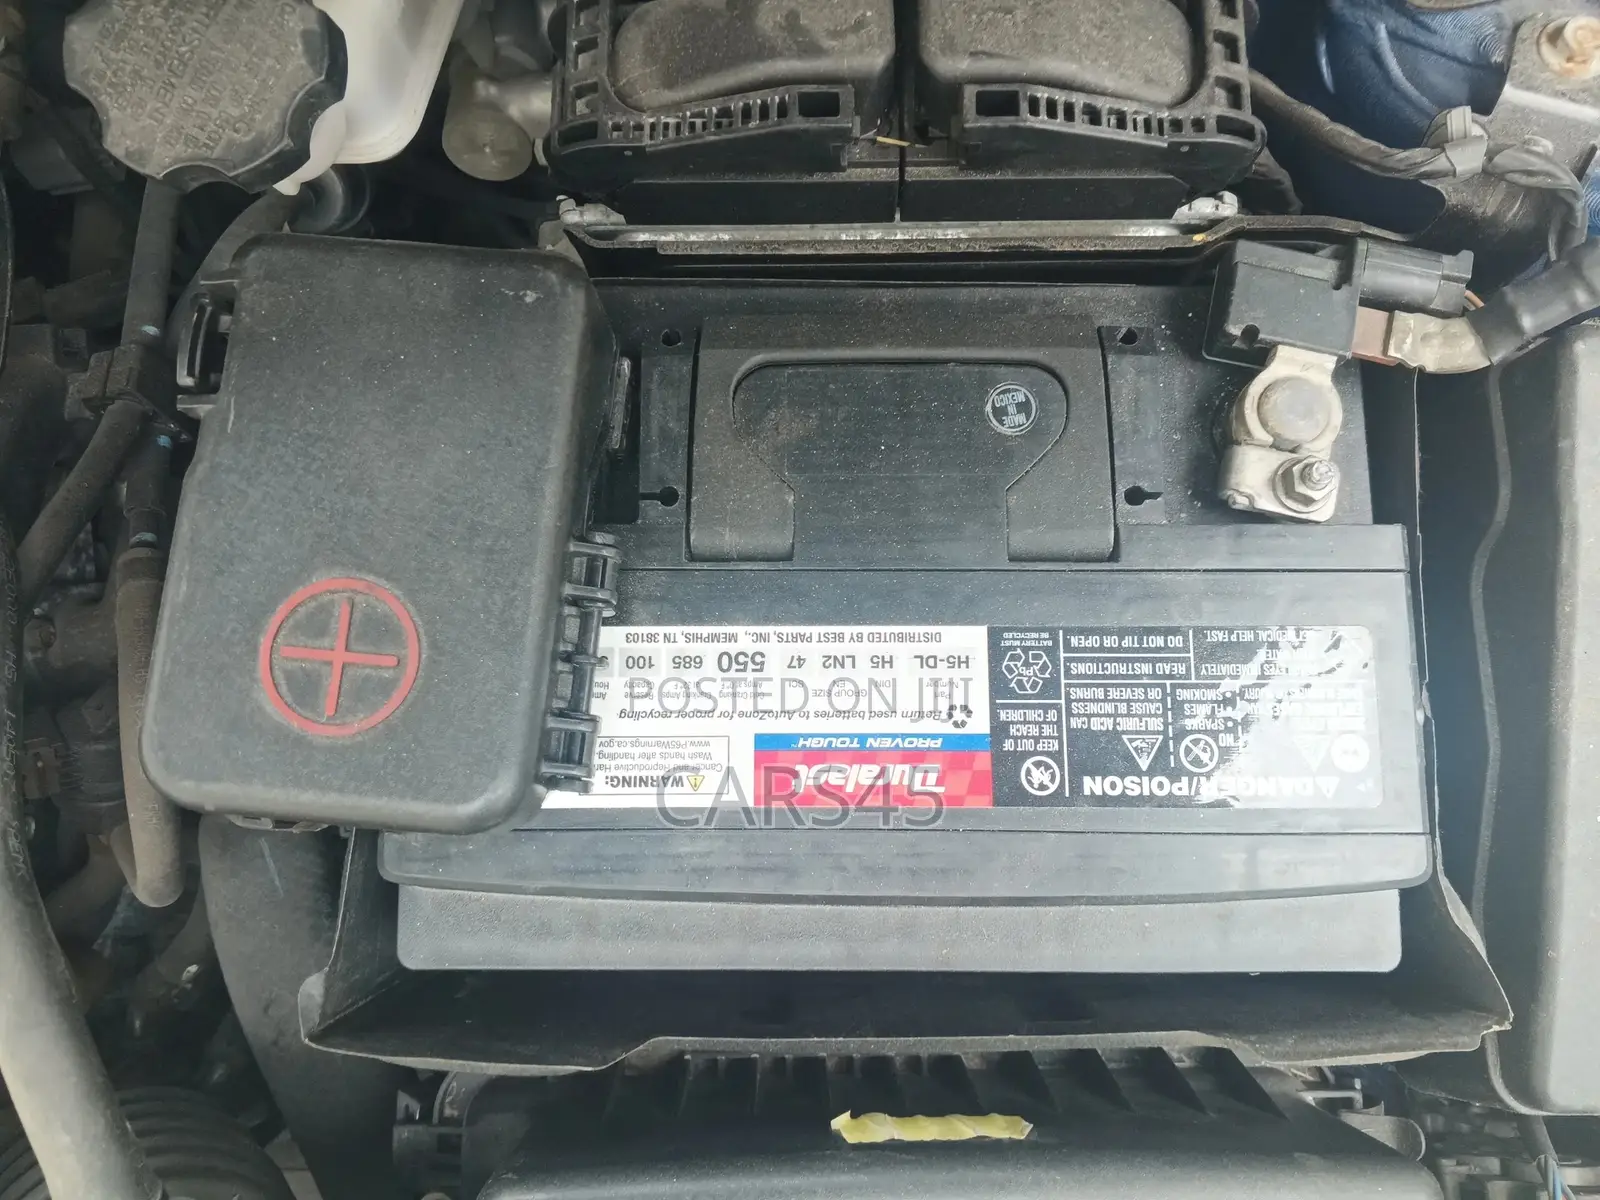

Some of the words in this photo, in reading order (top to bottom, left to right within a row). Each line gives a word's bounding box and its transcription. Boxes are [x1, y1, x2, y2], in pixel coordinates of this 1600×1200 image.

[994, 391, 1026, 407] MEXICO
[1007, 404, 1017, 415] IN
[1002, 412, 1027, 427] MADE
[625, 632, 660, 643] 38103
[663, 632, 678, 643] TN
[681, 631, 738, 643] MEMPHIS,
[773, 631, 812, 643] PARTS,
[816, 632, 845, 643] BEST
[849, 632, 863, 643] BY
[868, 632, 941, 643] DISTRIBUTED
[1067, 635, 1100, 647] OPEN.
[1103, 635, 1119, 647] OR
[1121, 635, 1141, 647] TIP
[1142, 635, 1165, 647] NOT
[1167, 635, 1183, 648] DO
[1204, 631, 1229, 642] FAST.
[1232, 631, 1254, 642] HELP
[626, 656, 655, 669] 100
[672, 655, 703, 669] 685
[717, 651, 766, 673] 550
[787, 655, 806, 669] 47
[822, 655, 856, 669] LN2
[870, 655, 893, 669] H5
[913, 655, 970, 669] H5-DL
[1020, 667, 1034, 676] Pb
[1067, 662, 1152, 675] INSTRUCTIONS.
[1156, 662, 1186, 675] READ
[811, 689, 832, 697] SIZE
[834, 689, 867, 697] GROUP
[1066, 688, 1104, 700] BURNS.
[1106, 688, 1145, 700] SEVERE
[1147, 688, 1162, 700] OR
[1176, 689, 1223, 701] SMOKING
[674, 708, 715, 720] proper
[1071, 702, 1127, 714] BLINDNESS
[1129, 702, 1163, 714] CAUSE
[1184, 703, 1225, 716] FLAMES
[717, 710, 734, 721] for
[738, 710, 796, 721] AutoZone
[798, 710, 810, 720] to
[814, 710, 866, 721] batteries
[870, 710, 896, 721] used
[901, 710, 942, 721] Return
[997, 710, 1044, 721] CHILDREN.
[1045, 710, 1057, 721] OF
[1070, 717, 1088, 729] CAN
[1090, 717, 1113, 731] ACID
[1116, 717, 1164, 731] SULFURIC
[1010, 725, 1039, 736] REACH
[1041, 725, 1059, 736] THE
[598, 738, 710, 749] www.P65Warnings.ca.gov
[866, 737, 943, 748] PROVEN
[1003, 739, 1014, 751] OF
[1016, 739, 1035, 751] OUT
[1036, 739, 1059, 751] KEEP
[1218, 733, 1237, 747] NO
[596, 750, 635, 761] handling.
[638, 752, 657, 761] after
[660, 752, 685, 761] hands
[688, 752, 712, 761] Wash
[594, 763, 611, 772] Har
[613, 762, 670, 772] Reproductive
[605, 775, 684, 788] WARNING:
[792, 764, 946, 793] Duralast
